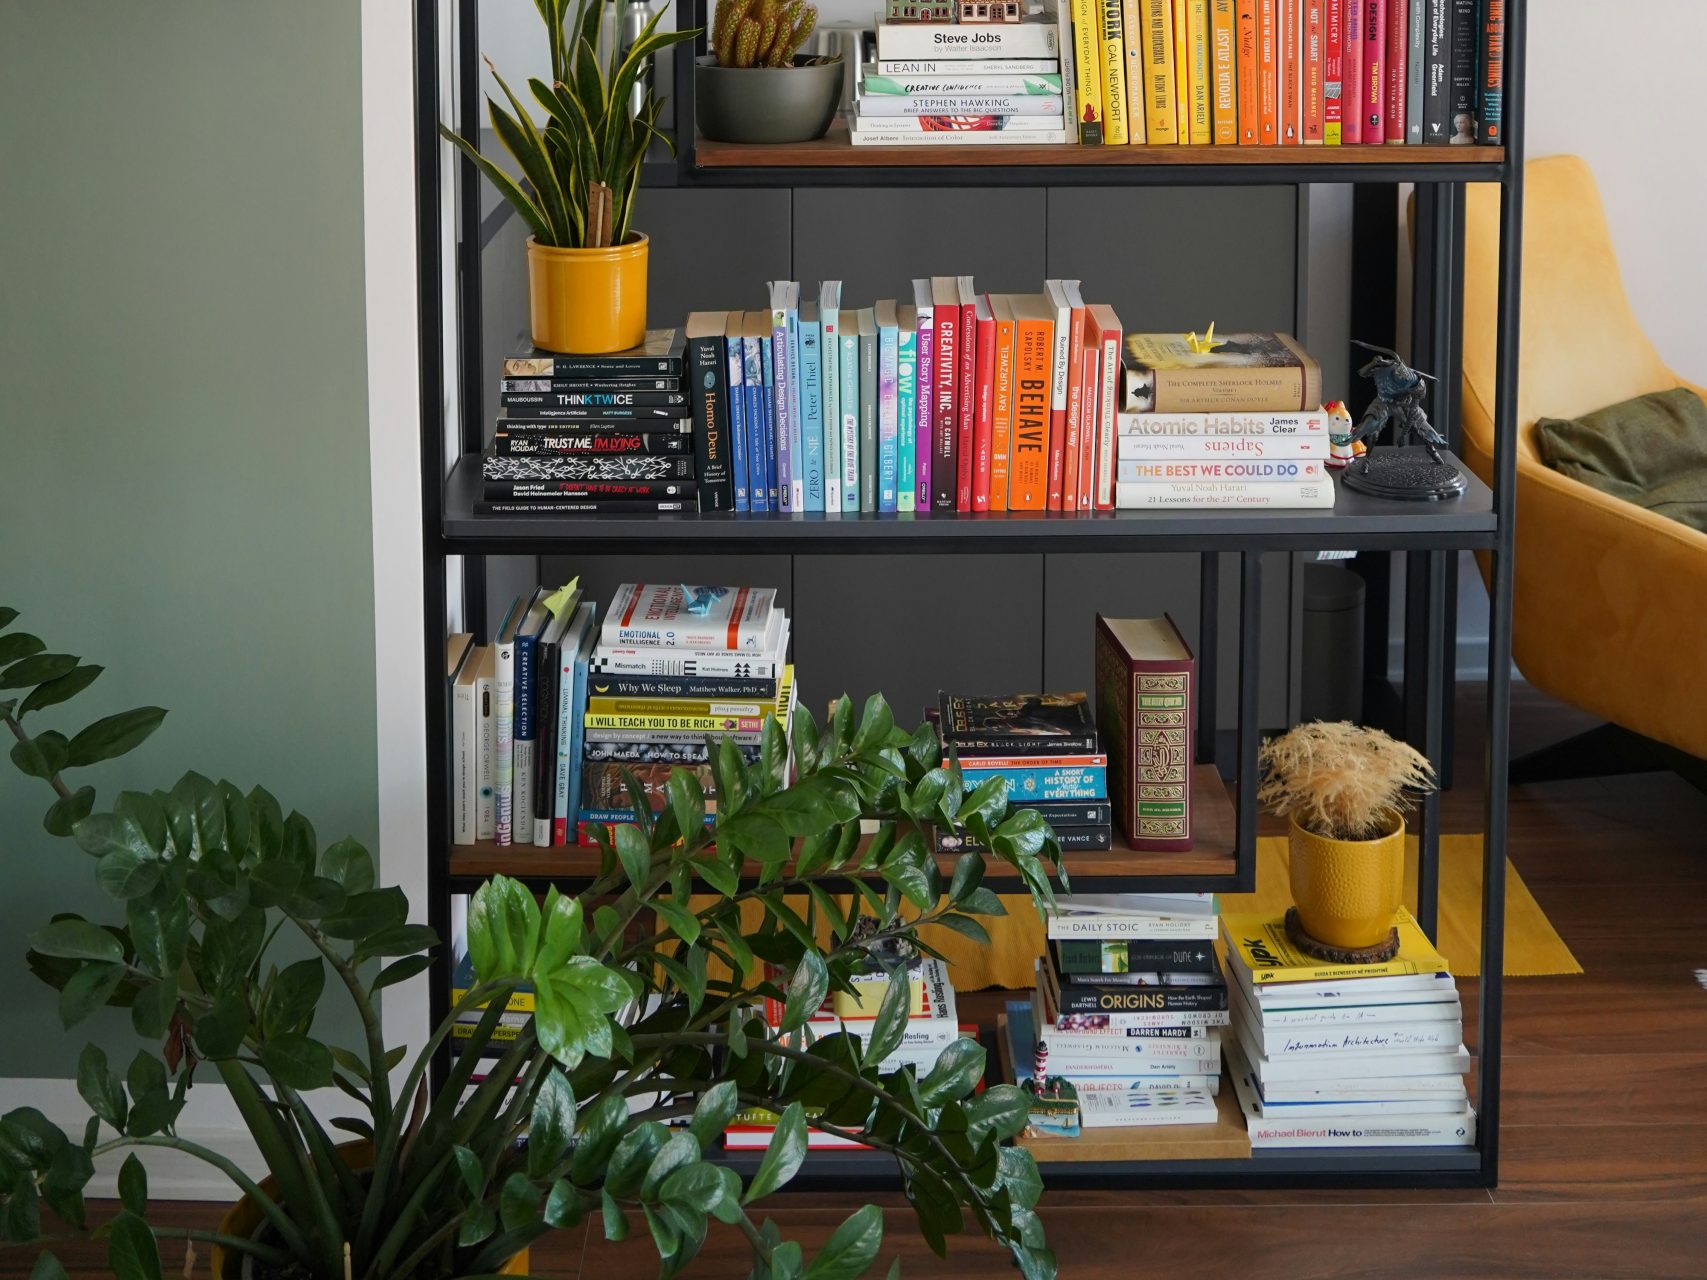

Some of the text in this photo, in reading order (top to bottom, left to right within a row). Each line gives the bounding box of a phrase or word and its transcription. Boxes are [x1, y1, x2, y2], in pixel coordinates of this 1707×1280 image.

[1310, 8, 1318, 24] NOT
[1368, 2, 1378, 40] DESIGN
[934, 32, 1002, 44] Steve Jobs
[1216, 28, 1230, 62] ATLASIT
[1108, 44, 1117, 66] CAL
[1310, 34, 1318, 62] SMART
[886, 64, 936, 74] LEAN IN
[904, 84, 983, 93] CREATIVE CONFIDENCE
[1110, 68, 1121, 122] NEWPORT
[1218, 72, 1231, 109] REVOLTA
[913, 98, 1010, 108] STEPHEN HAWKING
[898, 349, 916, 394] flow
[939, 321, 954, 413] CREATIVITY, INC.
[918, 333, 931, 428] User Story Mapping
[998, 346, 1010, 411] RAY KURZWEIL
[557, 394, 633, 404] THINK TWICE
[776, 331, 787, 452] Articulating Design Decisions
[806, 362, 816, 421] Peter Thiel
[1018, 379, 1045, 454] BEHAVE
[1270, 418, 1298, 426] James
[705, 392, 718, 460] Homo Deus
[1128, 418, 1265, 434] Atomic Habits
[1272, 426, 1296, 434] Clear
[543, 438, 640, 450] TRUST ME, I'M LYING
[1204, 438, 1264, 456] Sapiens
[1136, 464, 1298, 476] THE BEST WE COULD DO
[618, 630, 661, 640] EMOTIONAL
[666, 632, 675, 646] 2.0
[614, 662, 646, 670] Mismatch
[618, 683, 682, 694] Why We Sleep
[520, 693, 528, 737] SELECTION
[590, 717, 715, 728] I WILL TEACH YOU TO BE RICH
[1044, 776, 1082, 784] HISTORY
[1044, 790, 1096, 798] EVERYTHING
[1072, 923, 1140, 932] DAILY STOIC
[1100, 994, 1164, 1009] ORIGINS
[1130, 1028, 1187, 1037] DARREN HARDY
[1257, 1130, 1296, 1138] Michael
[1296, 1129, 1326, 1138] Bierut
[1328, 1129, 1351, 1137] How
